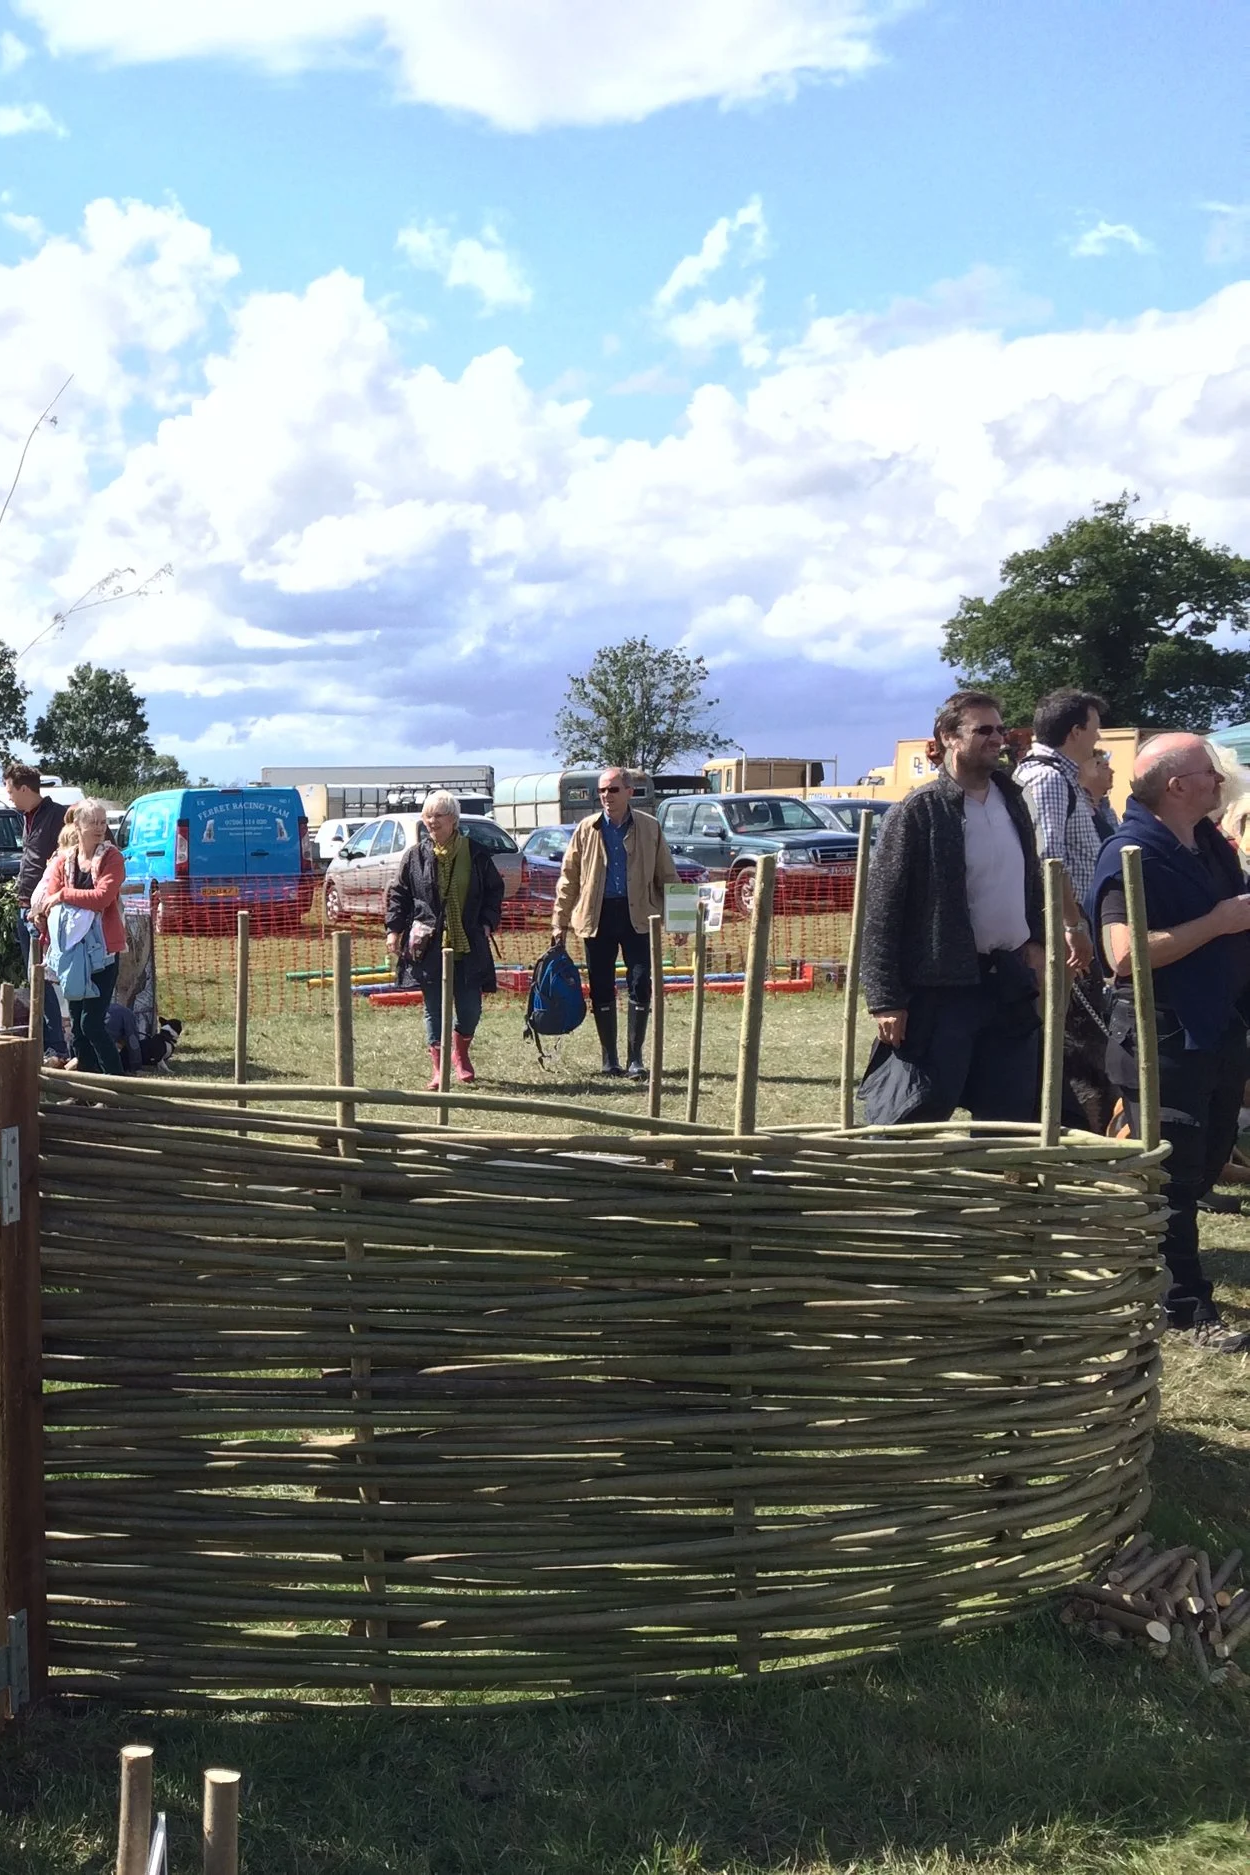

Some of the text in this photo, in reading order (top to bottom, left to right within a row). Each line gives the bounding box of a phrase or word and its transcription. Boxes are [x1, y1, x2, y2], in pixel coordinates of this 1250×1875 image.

[197, 801, 290, 820] FERRET RACING TEAM
